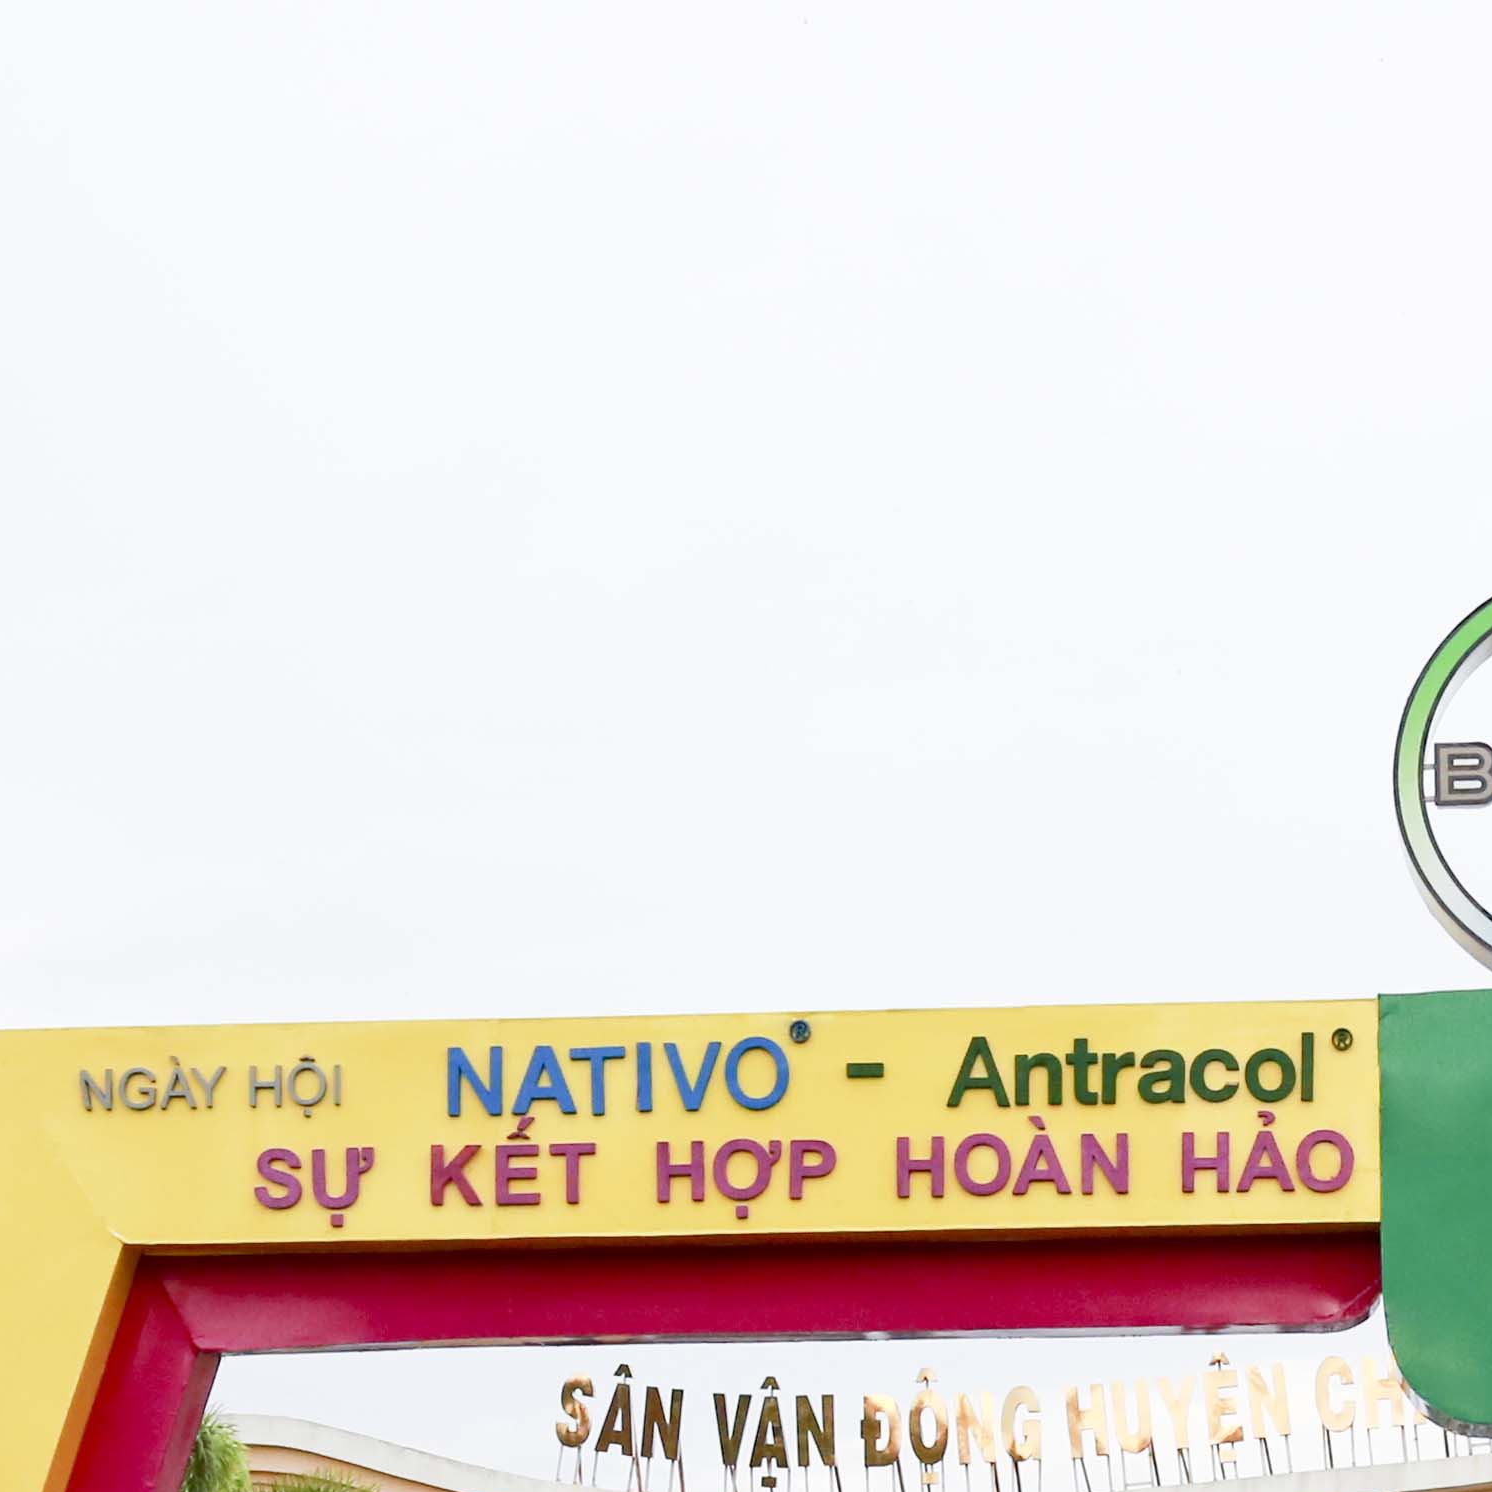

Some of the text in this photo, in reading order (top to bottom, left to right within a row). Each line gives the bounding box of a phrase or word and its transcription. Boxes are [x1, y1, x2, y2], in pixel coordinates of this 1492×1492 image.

[79, 1055, 227, 1112] NGÀY
[248, 1055, 342, 1118] HỘI
[254, 1111, 1355, 1228] SỰ KẾT HỢP HOÀN HẢO
[555, 1363, 685, 1461] SÂN
[712, 1376, 836, 1488] VẬN
[860, 1366, 1043, 1485] ĐỘNG
[1065, 1350, 1293, 1464] HUYỆN
